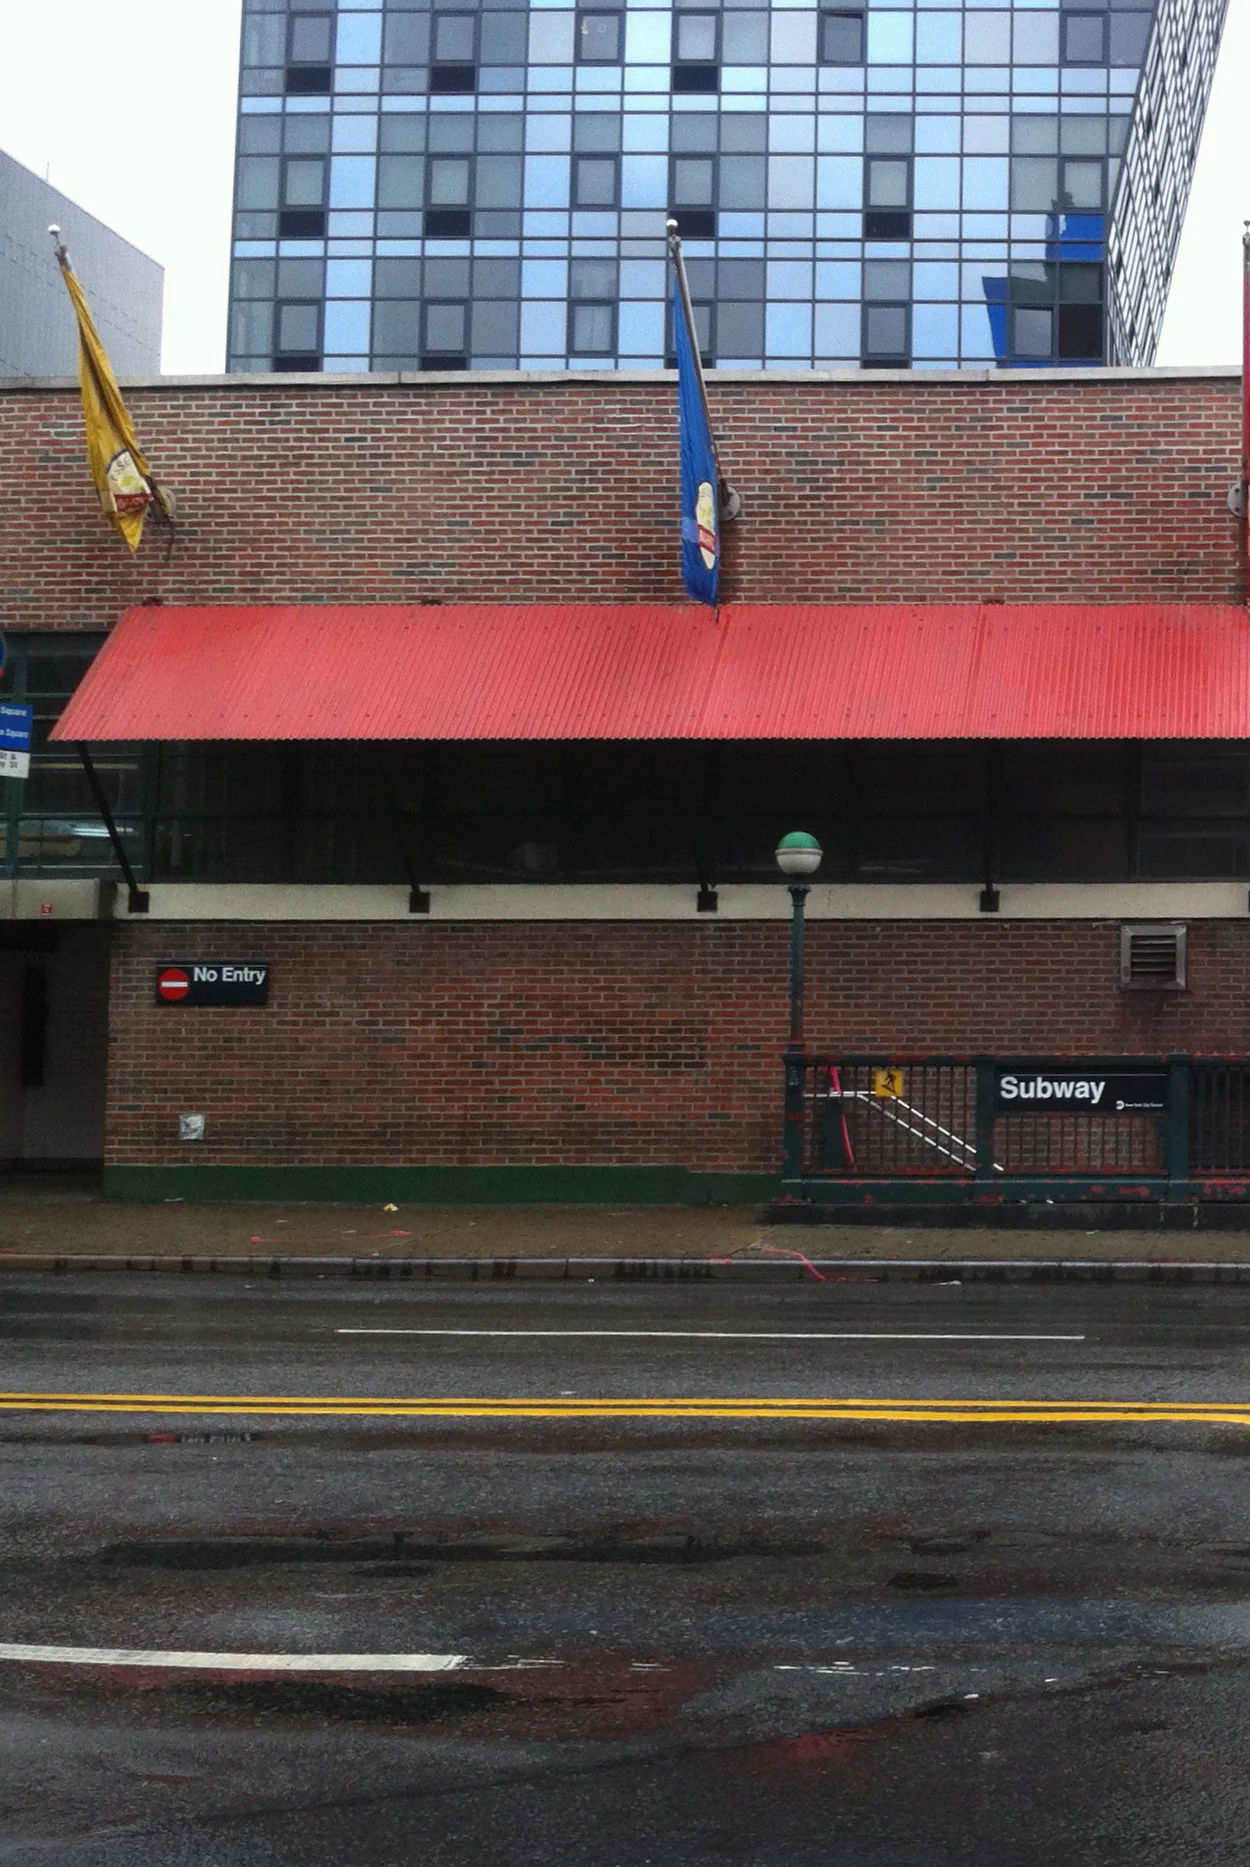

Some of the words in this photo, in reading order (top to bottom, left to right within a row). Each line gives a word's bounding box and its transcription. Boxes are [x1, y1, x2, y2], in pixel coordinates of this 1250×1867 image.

[194, 966, 218, 982] No
[222, 966, 267, 985] Entry
[1000, 1076, 1106, 1104] Subway
